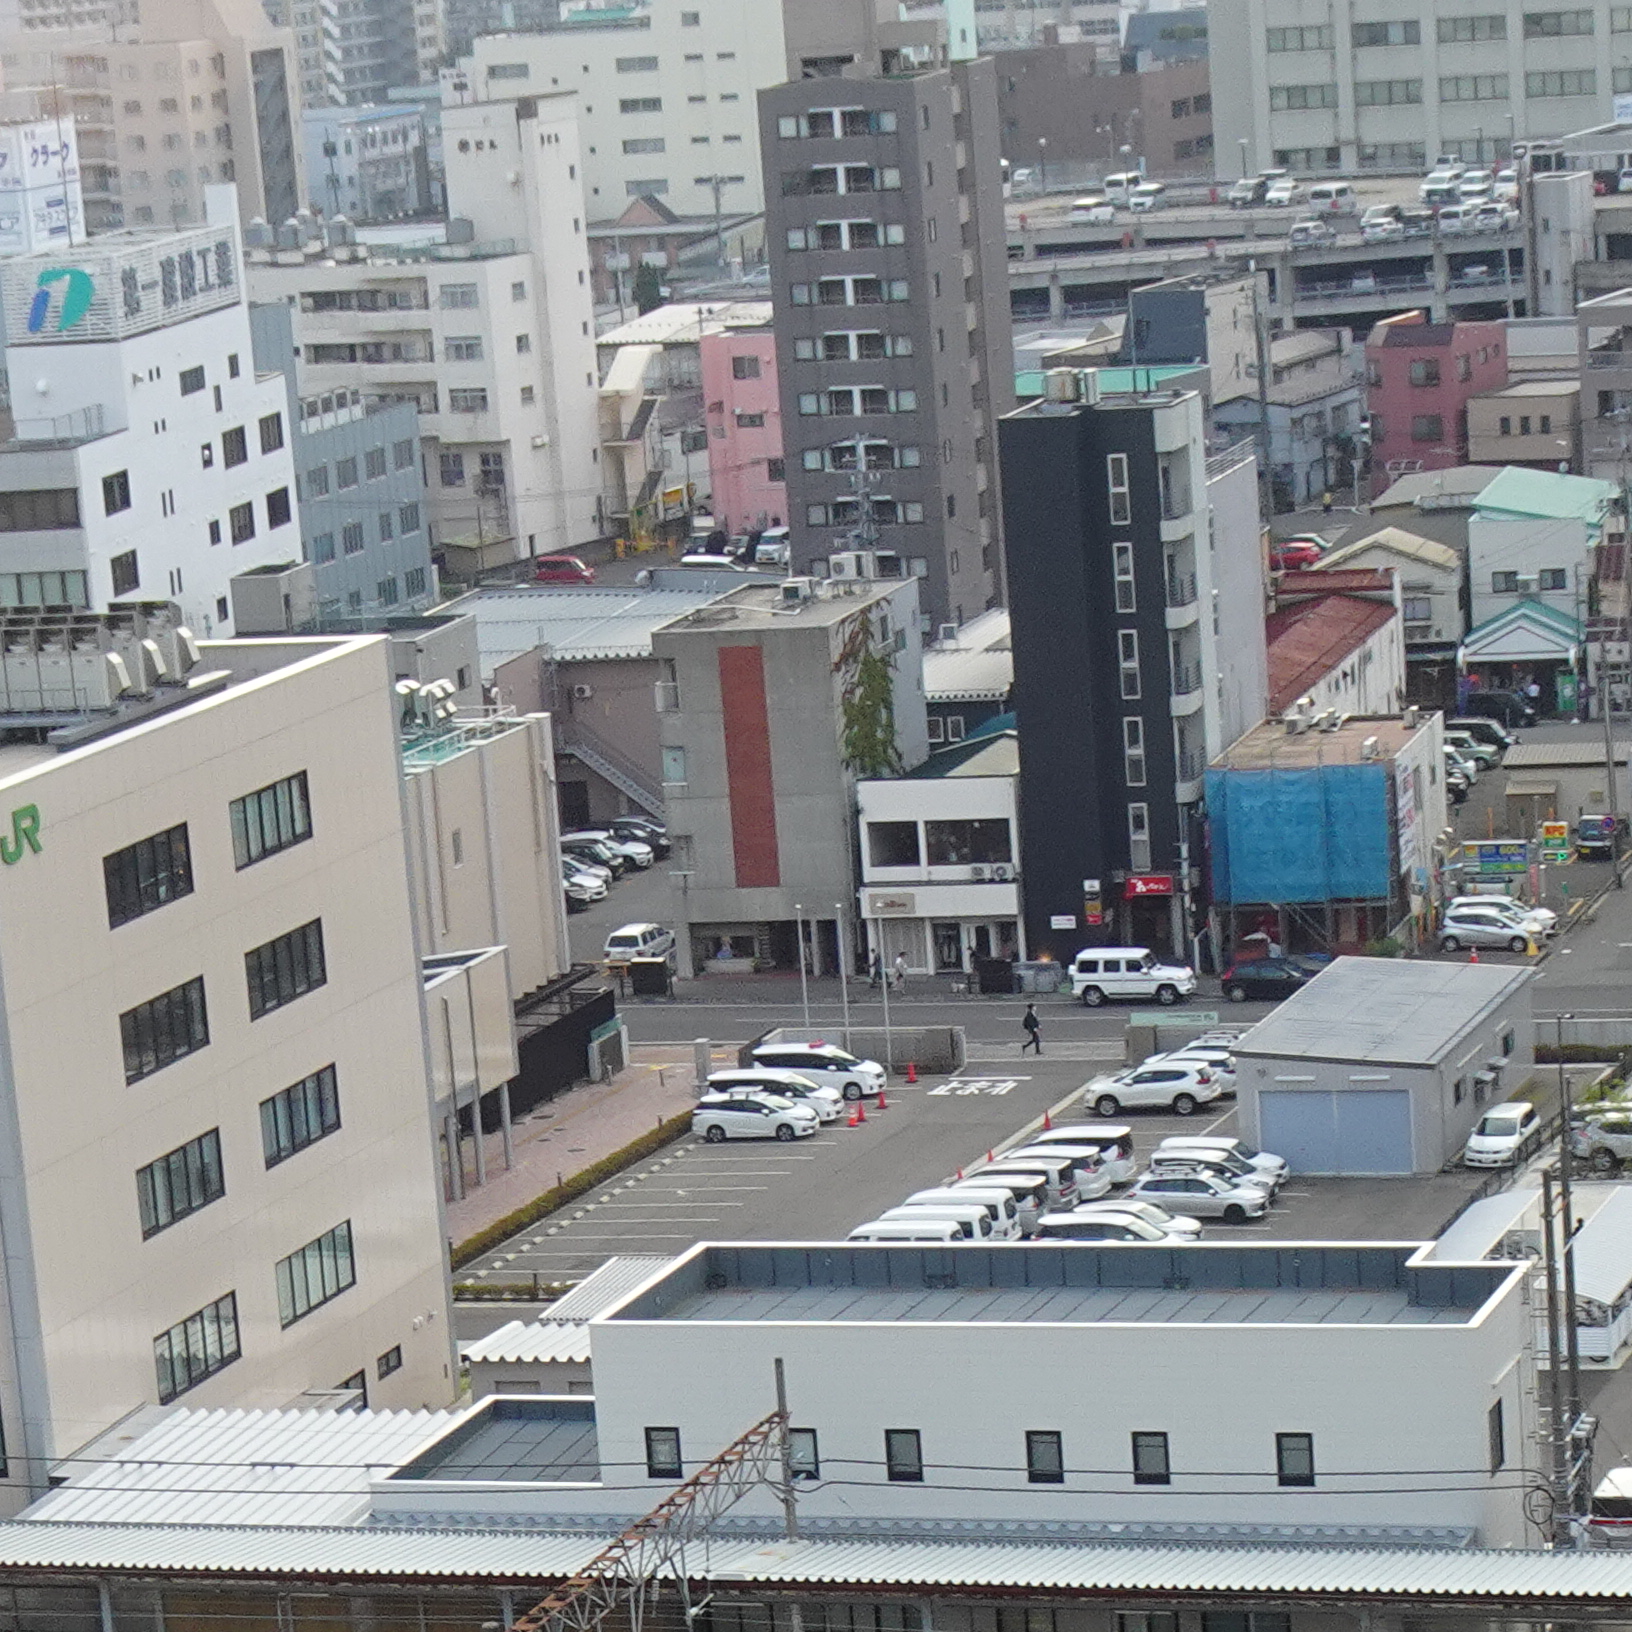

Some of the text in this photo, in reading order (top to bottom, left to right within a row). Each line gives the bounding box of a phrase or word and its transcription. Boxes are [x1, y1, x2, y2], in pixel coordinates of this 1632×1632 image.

[0, 803, 43, 865] JR
[926, 1081, 1019, 1096] 止まれ
